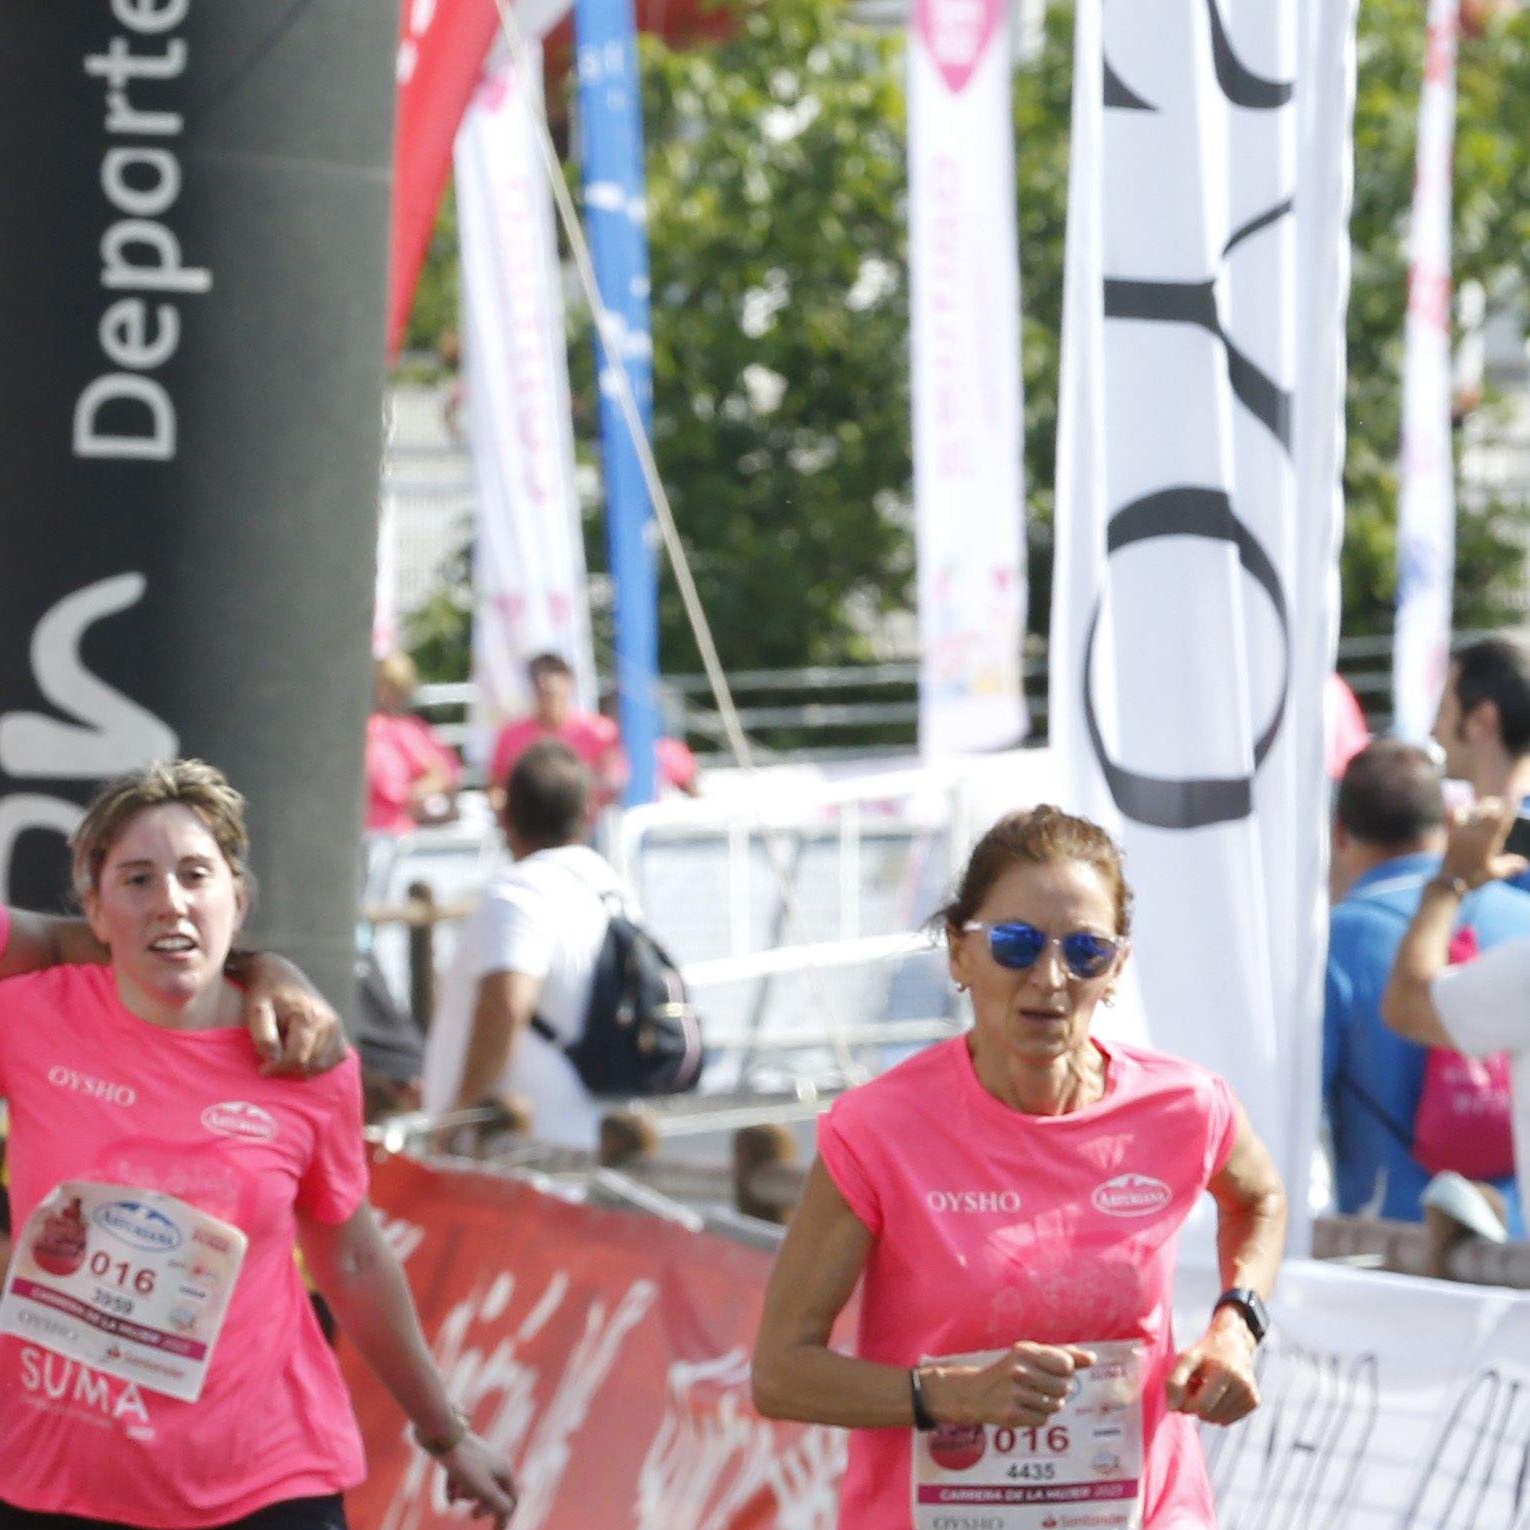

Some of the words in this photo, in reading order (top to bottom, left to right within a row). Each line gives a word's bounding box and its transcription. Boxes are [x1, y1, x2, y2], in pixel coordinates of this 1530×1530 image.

[48, 1065, 137, 1108] OYSHO
[927, 1190, 1022, 1215] OYSHO
[91, 1251, 157, 1295] 016
[20, 1347, 151, 1423] SUMA
[994, 1425, 1070, 1452] 016
[1006, 1463, 1056, 1480] 4435
